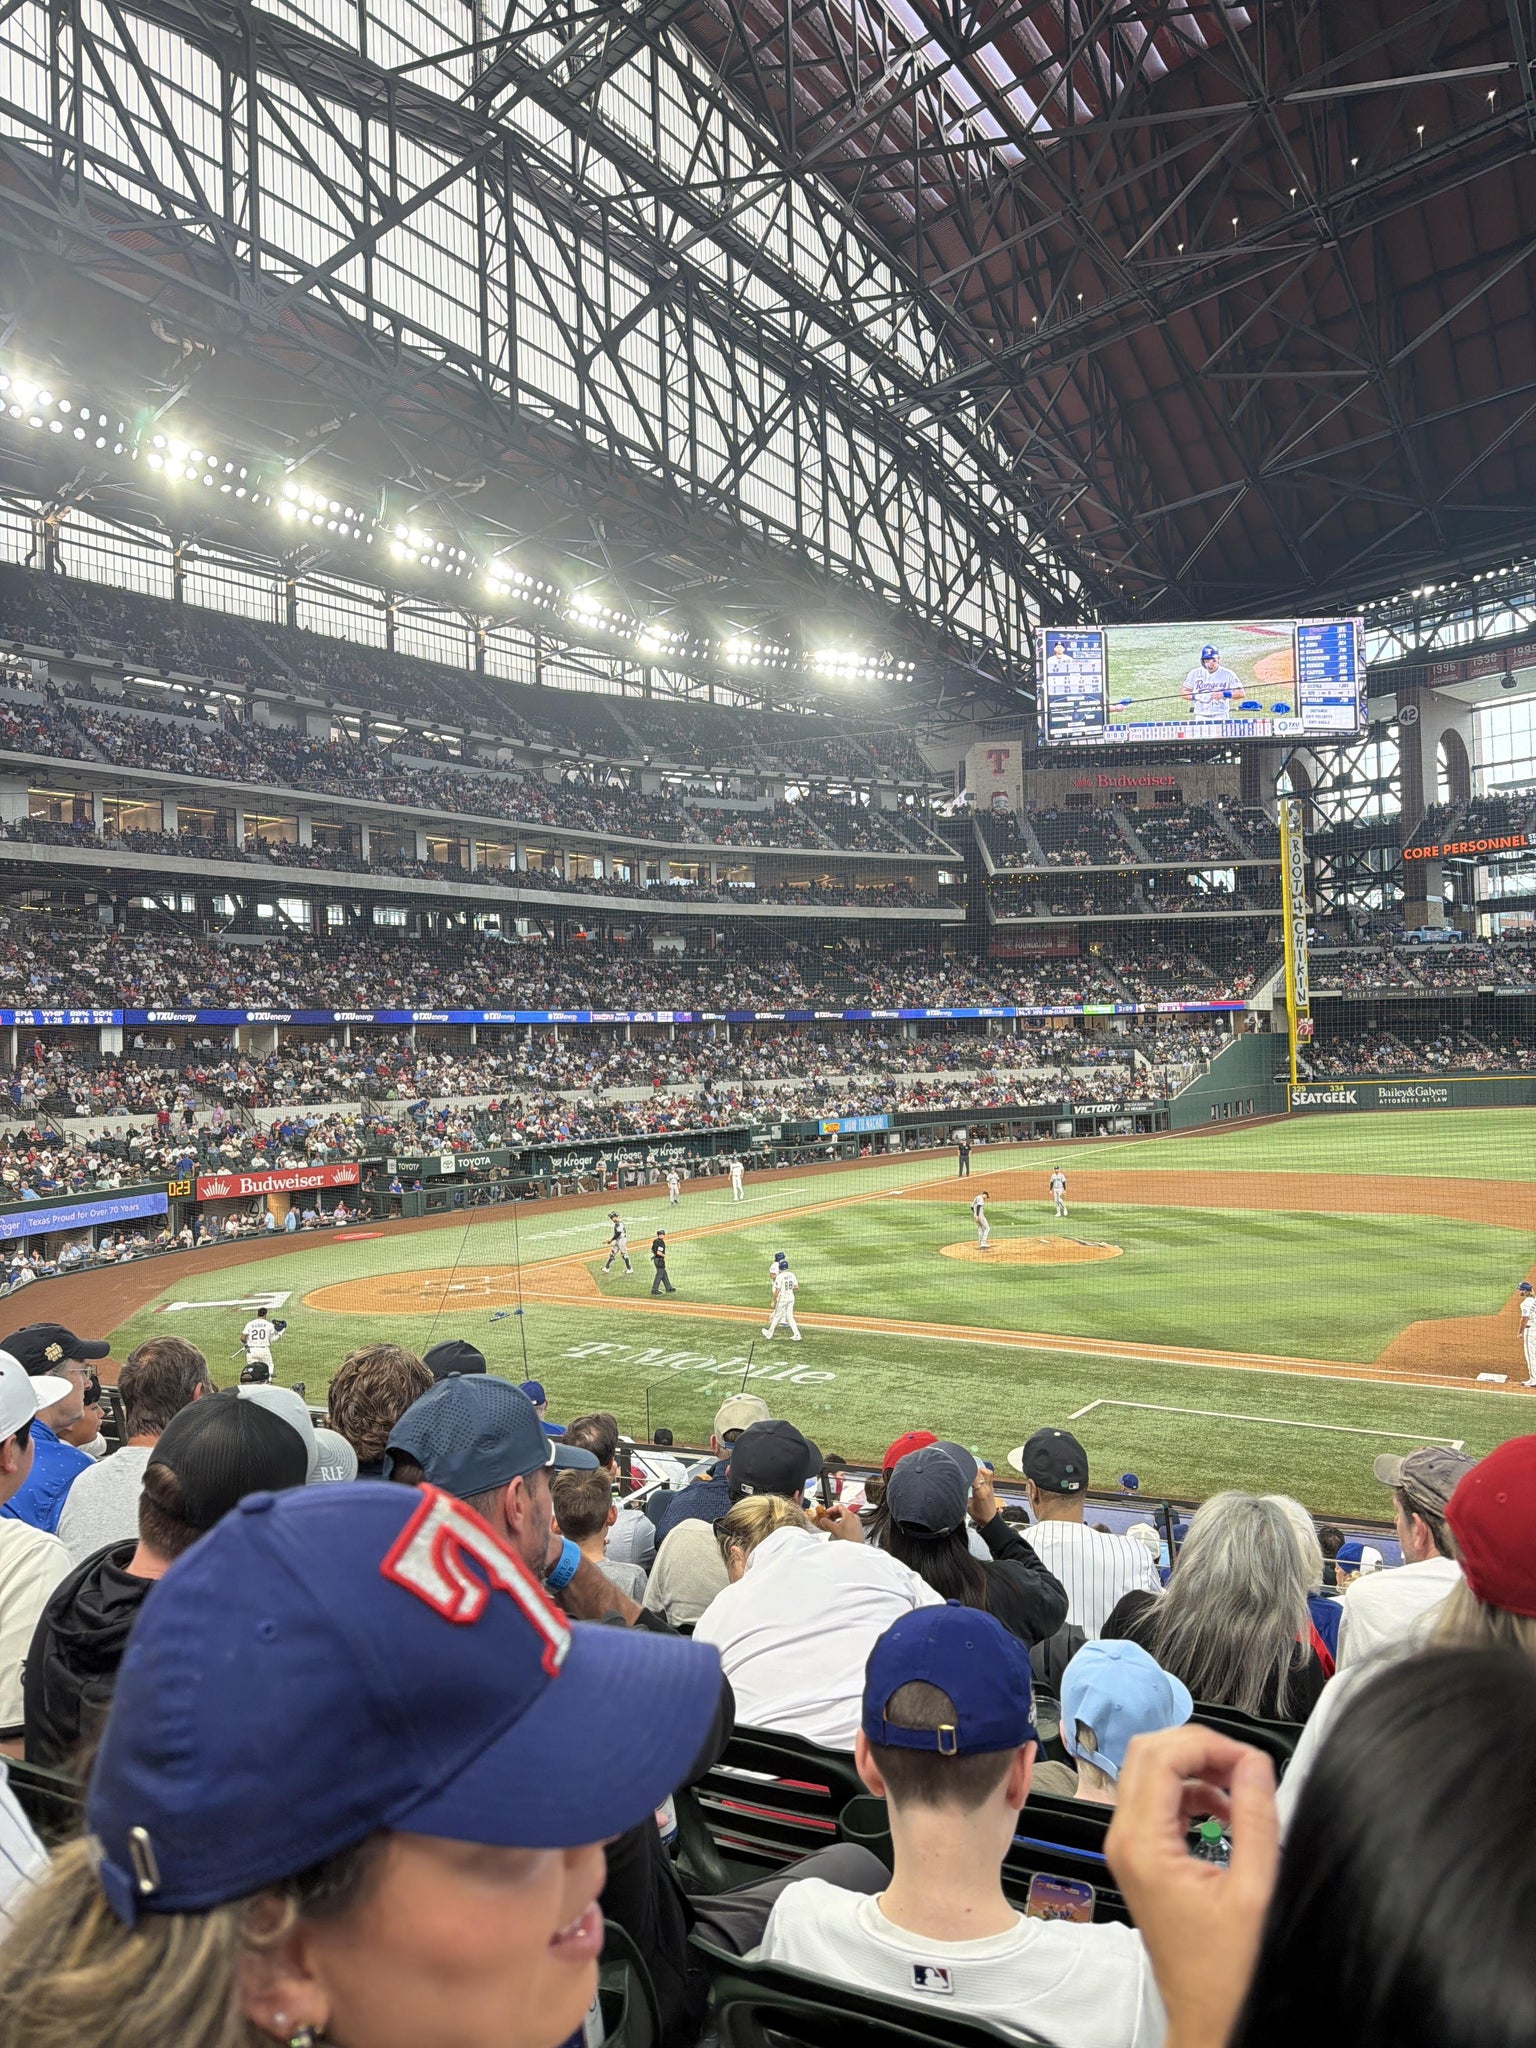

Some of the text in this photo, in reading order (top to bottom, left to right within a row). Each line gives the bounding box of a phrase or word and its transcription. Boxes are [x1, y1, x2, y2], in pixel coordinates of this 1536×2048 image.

[1400, 709, 1418, 722] 42
[1096, 775, 1175, 788] Budweiser
[1403, 845, 1439, 860] CORE
[1443, 834, 1528, 856] PERSONNEL
[1347, 991, 1372, 999] SHIFT
[1414, 989, 1438, 997] SHIFT
[1329, 1084, 1344, 1092] 334
[1292, 1090, 1357, 1105] SEATGEEK
[1074, 1103, 1118, 1114] VICTORY
[660, 1142, 686, 1162] Kroger
[458, 1157, 491, 1168] TOYOTA
[563, 1152, 593, 1172] Kroger
[239, 1173, 324, 1194] Budweiser
[28, 1216, 51, 1227] Texas
[52, 1213, 76, 1224] Proud
[77, 1211, 88, 1220] for
[90, 1208, 108, 1218] Over
[110, 1206, 119, 1215] 70
[121, 1203, 140, 1213] Years
[251, 1329, 266, 1340] 20
[320, 1466, 344, 1481] RLF
